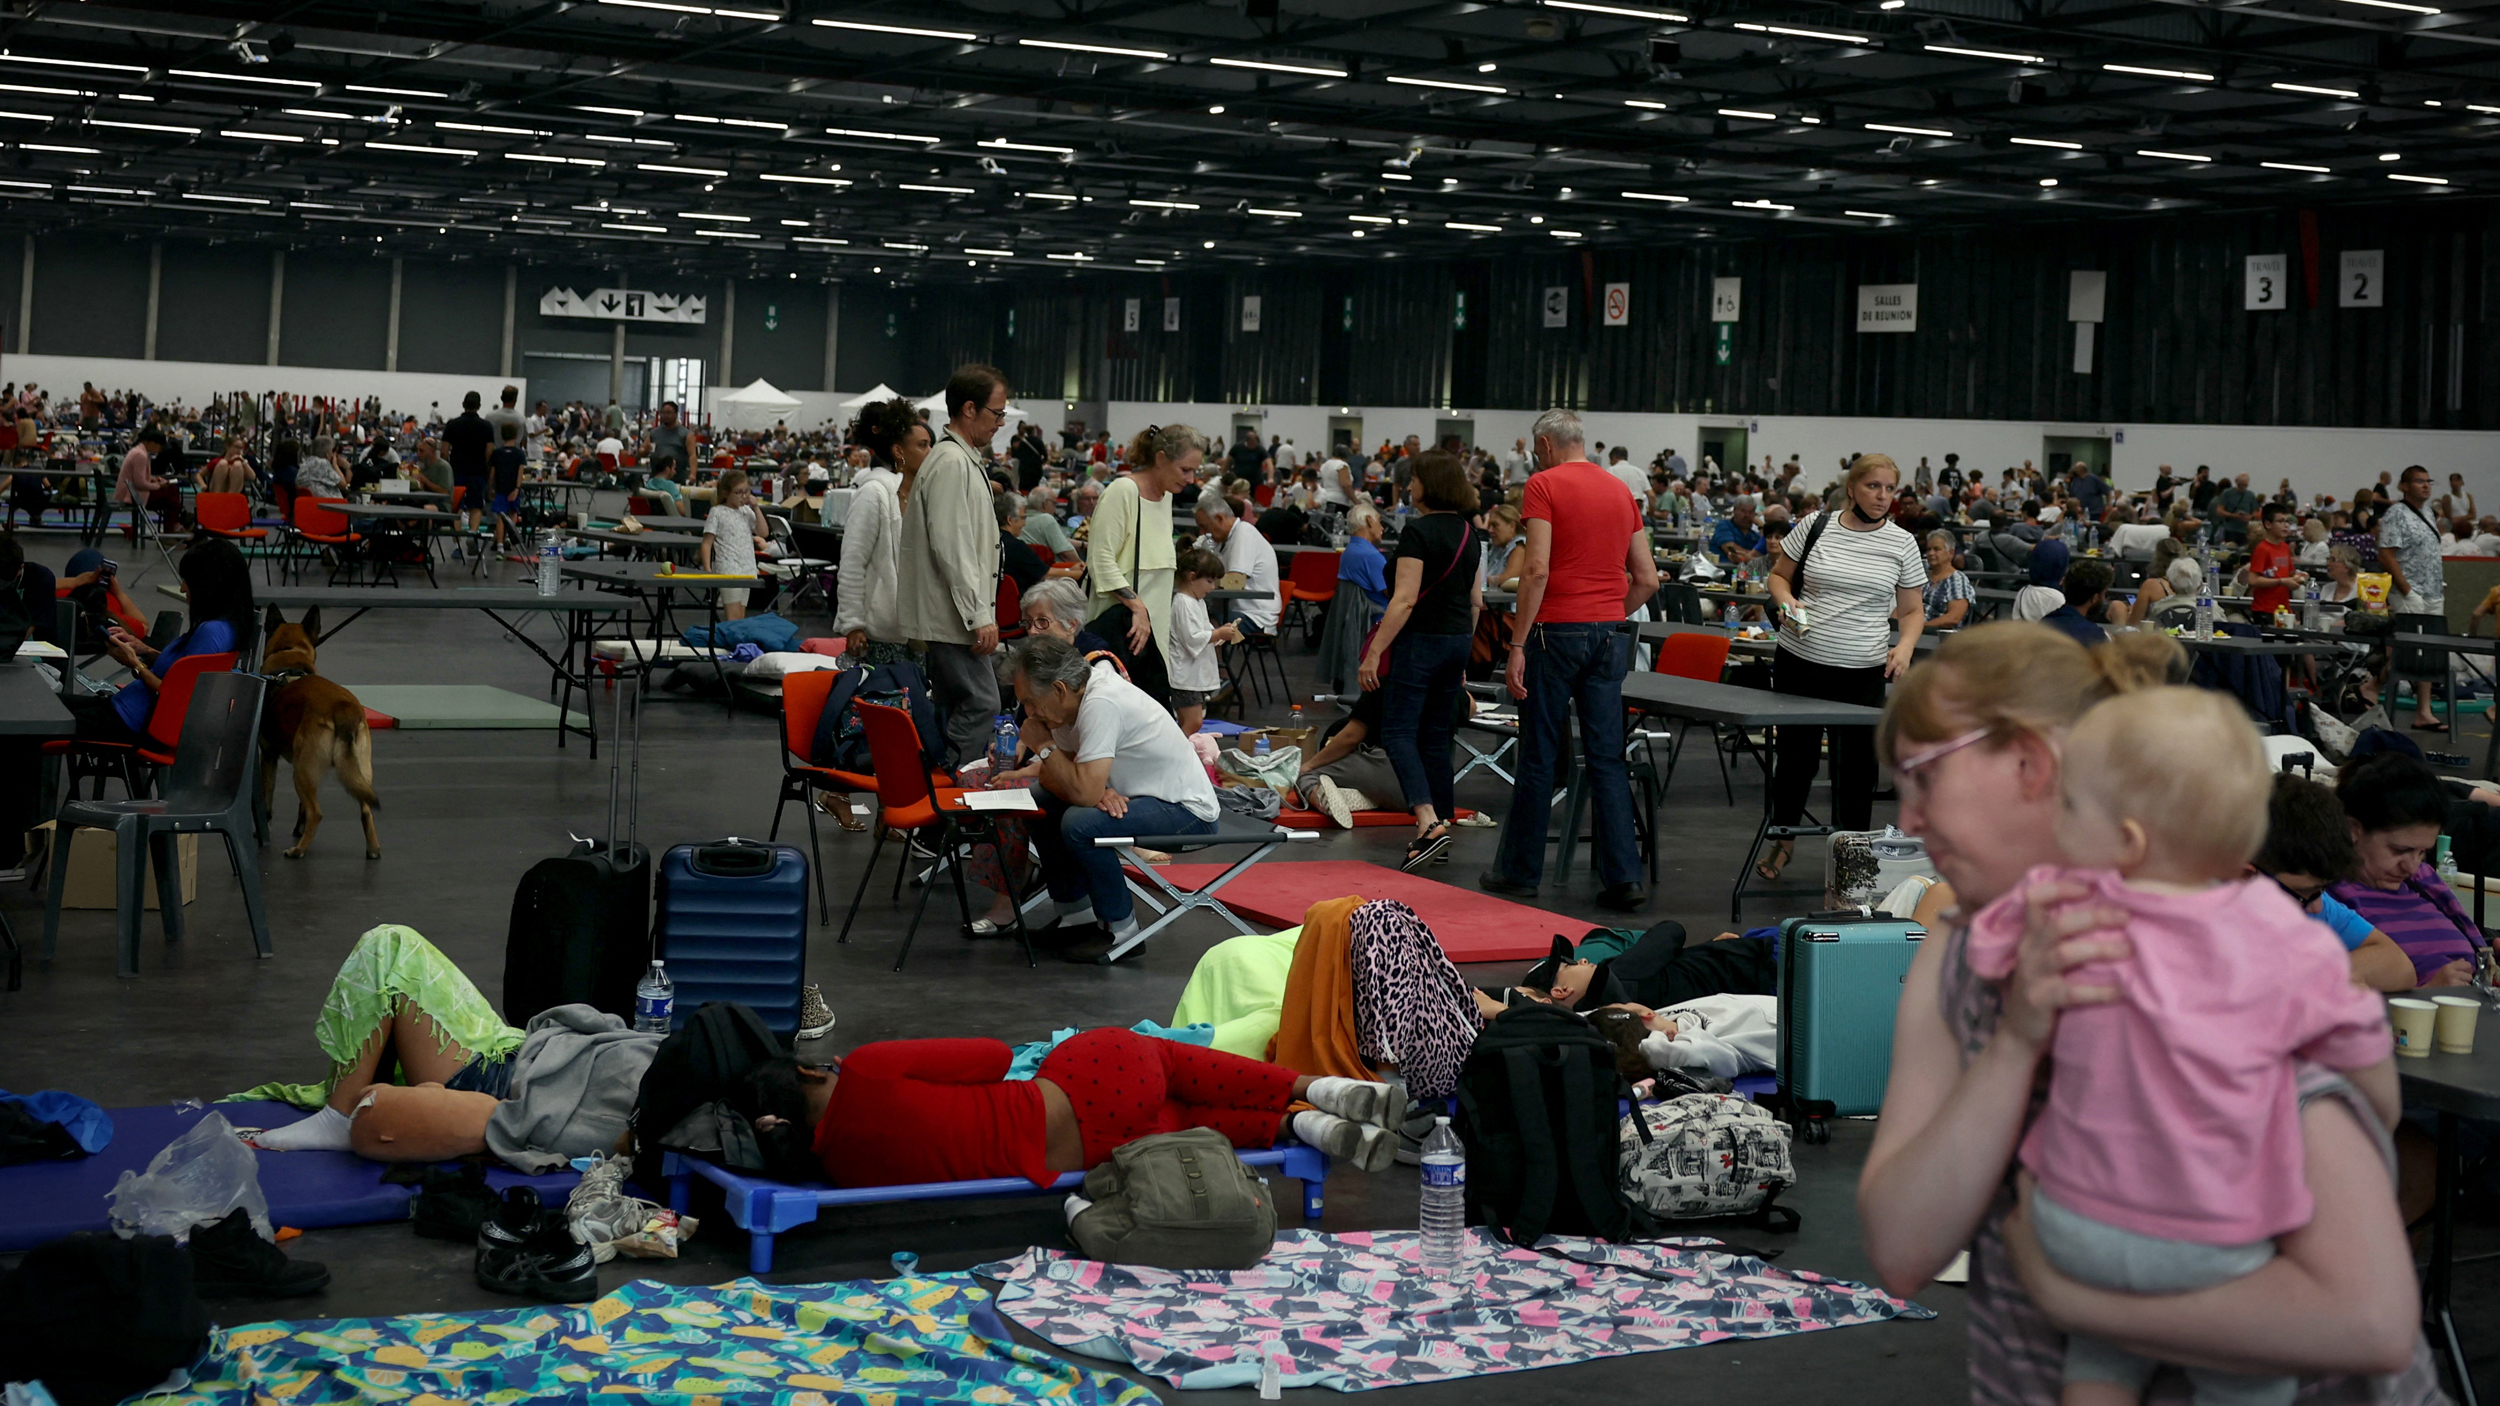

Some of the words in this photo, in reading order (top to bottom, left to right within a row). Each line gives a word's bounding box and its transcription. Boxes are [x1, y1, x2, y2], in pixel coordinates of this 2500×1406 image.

[2252, 260, 2281, 272] TRAVEL
[2259, 277, 2273, 303] 3
[2353, 273, 2369, 300] 2
[630, 299, 640, 316] 1
[1874, 295, 1902, 306] SALLES
[1129, 312, 1135, 327] 5
[1168, 311, 1174, 325] 4
[1862, 311, 1872, 321] DE
